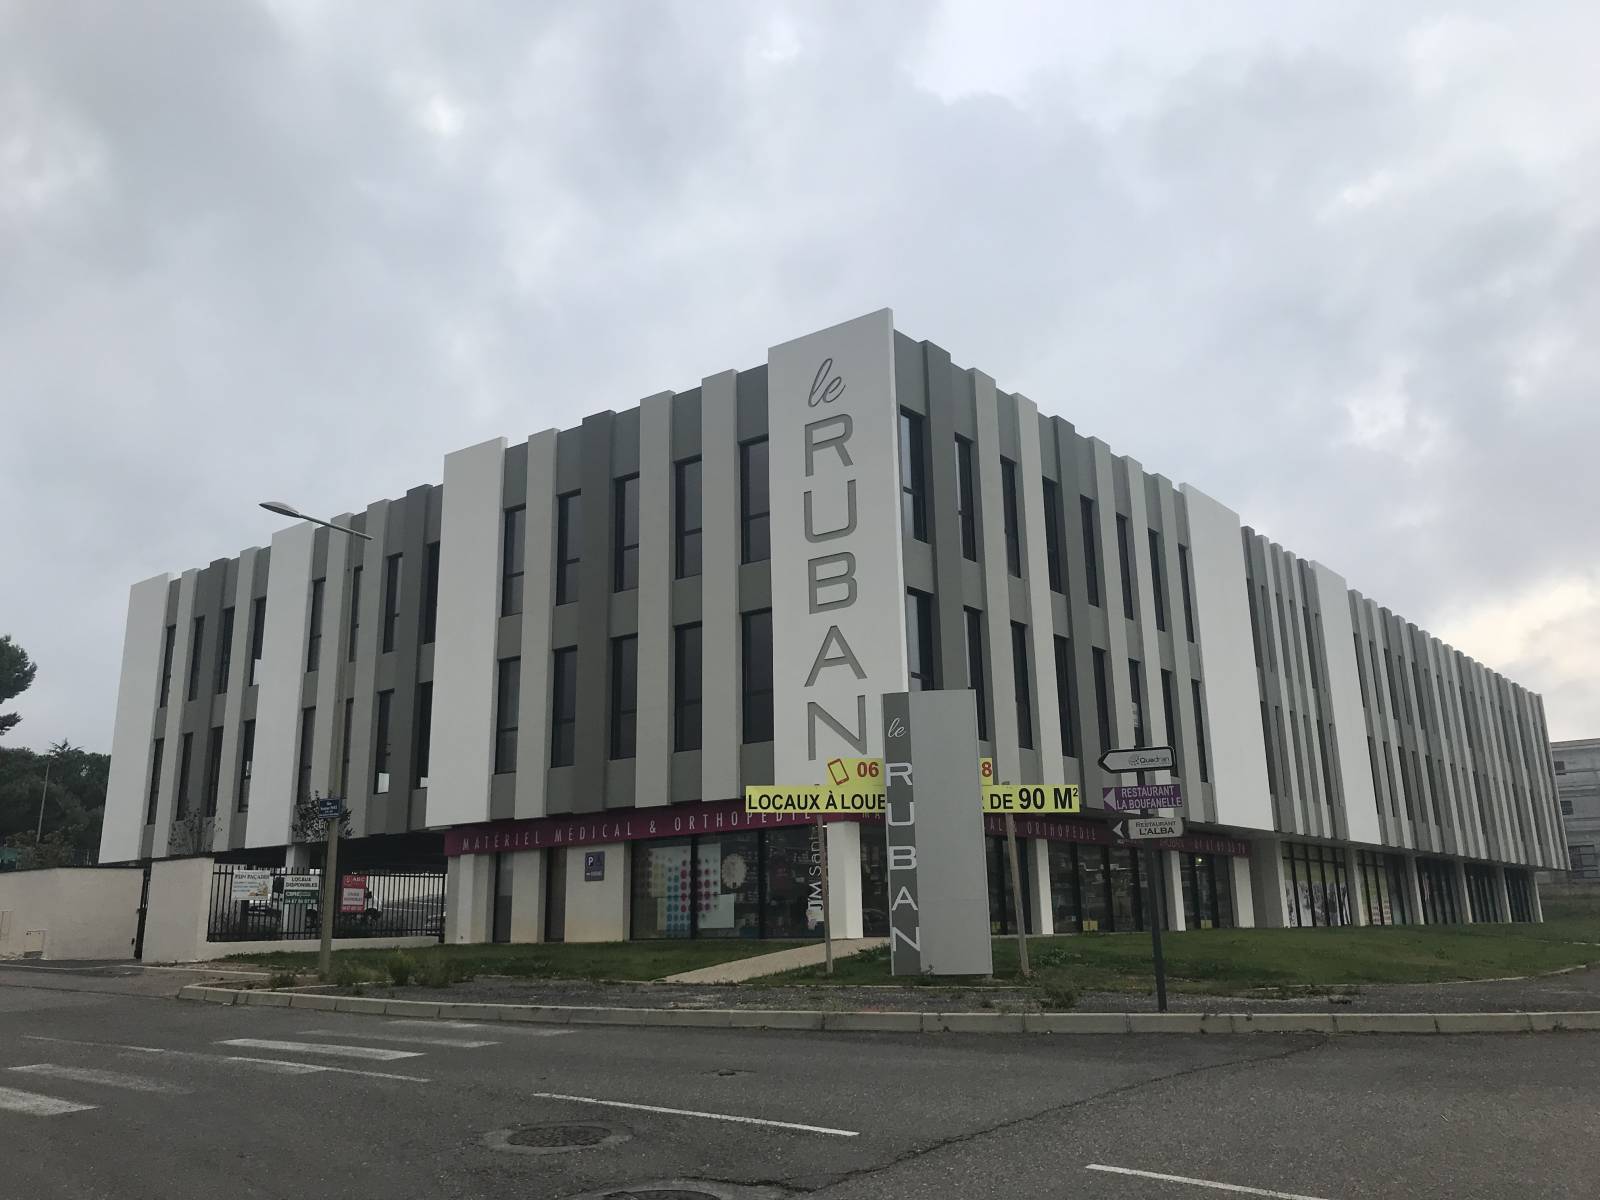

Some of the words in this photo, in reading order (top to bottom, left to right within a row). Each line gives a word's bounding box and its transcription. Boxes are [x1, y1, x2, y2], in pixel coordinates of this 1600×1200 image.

[808, 358, 846, 407] le
[804, 413, 867, 761] RUBAN
[887, 717, 906, 738] le
[856, 762, 880, 778] 06
[748, 793, 820, 811] LOCAUX
[825, 790, 843, 810] À
[841, 793, 886, 811] LOUE
[989, 793, 1014, 810] DE
[1018, 787, 1046, 810] 90
[1121, 786, 1175, 798] RESTAURANT
[1116, 799, 1128, 810] LA
[649, 820, 656, 833] &
[1139, 827, 1175, 836] L'ALBA
[808, 827, 822, 877] Sant
[885, 762, 921, 952] RUBAN
